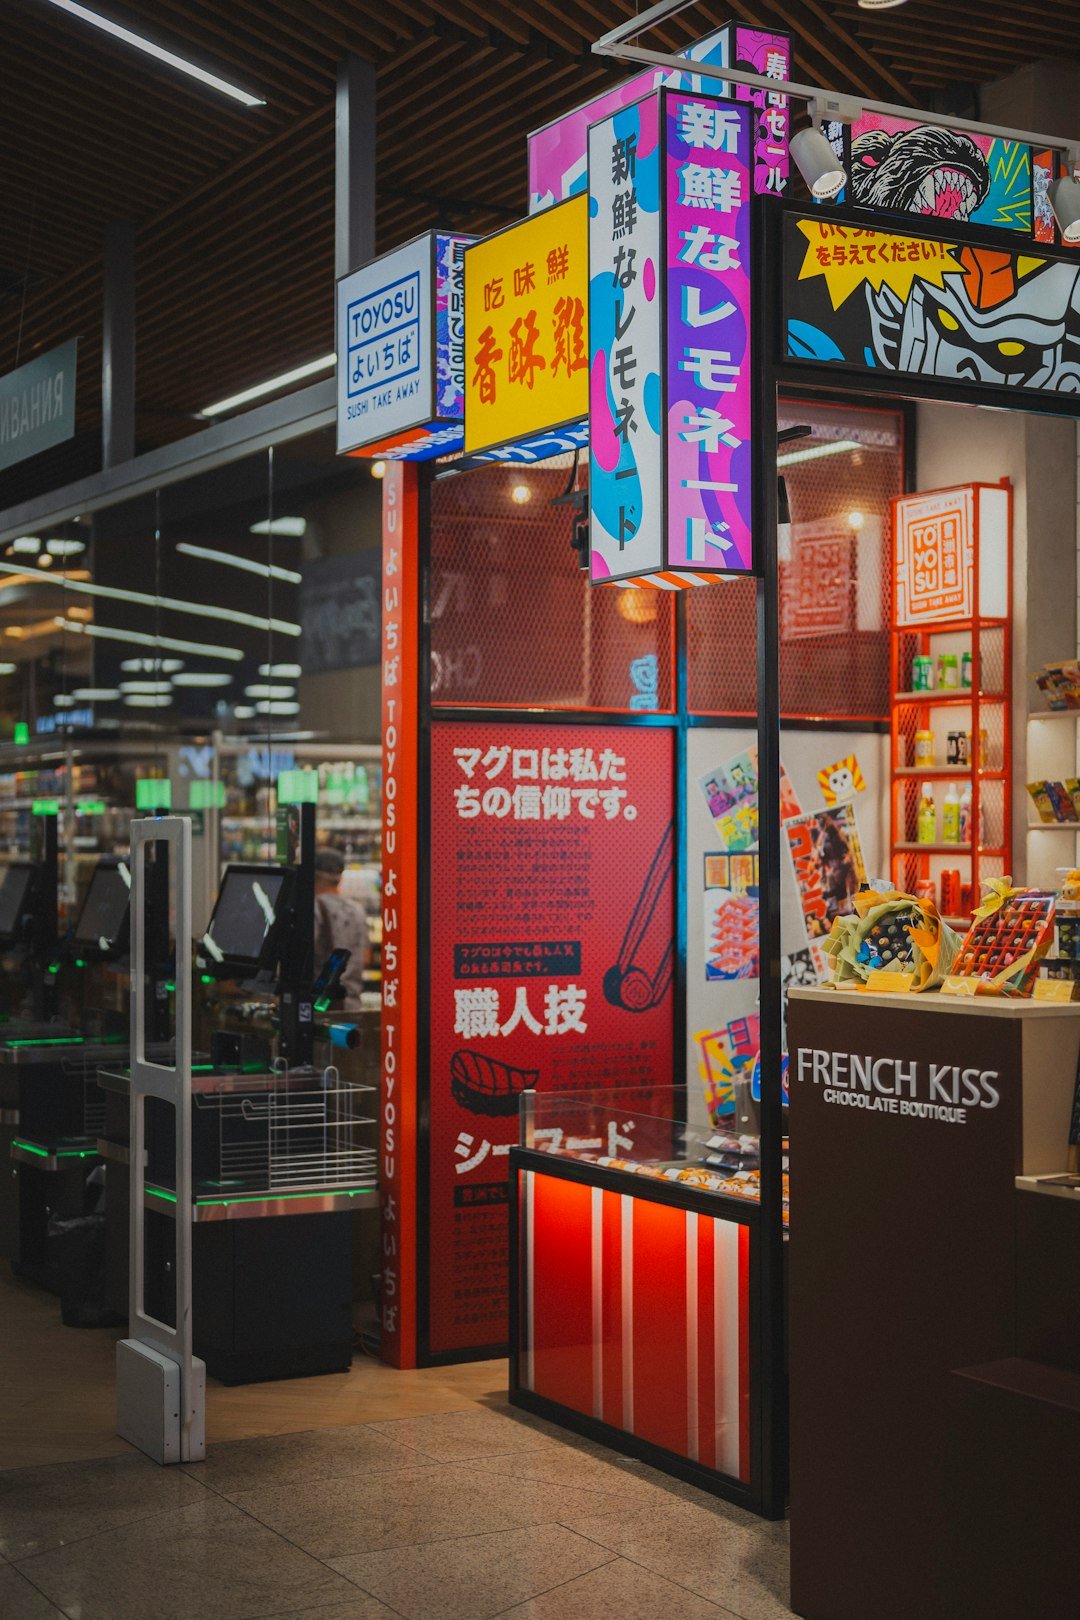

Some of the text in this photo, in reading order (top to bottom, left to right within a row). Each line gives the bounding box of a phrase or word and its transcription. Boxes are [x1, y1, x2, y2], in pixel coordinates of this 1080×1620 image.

[484, 244, 570, 313] 吃味鮮
[815, 241, 945, 268] を与えてください！
[352, 286, 415, 338] TOYOSU
[611, 132, 638, 551] 新鮮なレモネード
[677, 101, 743, 562] 新鮮なレモネード
[351, 331, 416, 384] よいちば
[472, 295, 589, 406] 香酥雞
[347, 379, 421, 421] SUSHI TAKE AWAY
[915, 569, 938, 593] SU
[385, 548, 400, 687] よいちば
[385, 700, 398, 854] TOYOSU
[453, 745, 627, 782] マグロは私た
[453, 784, 638, 820] ちの信仰です。
[384, 868, 399, 1007] よいちば
[453, 984, 588, 1040] 職人技
[384, 1024, 397, 1179] TOYOSU
[797, 1047, 1000, 1109] FRENCH KISS
[823, 1088, 967, 1125] CHOCOLATE BOUTIQUE
